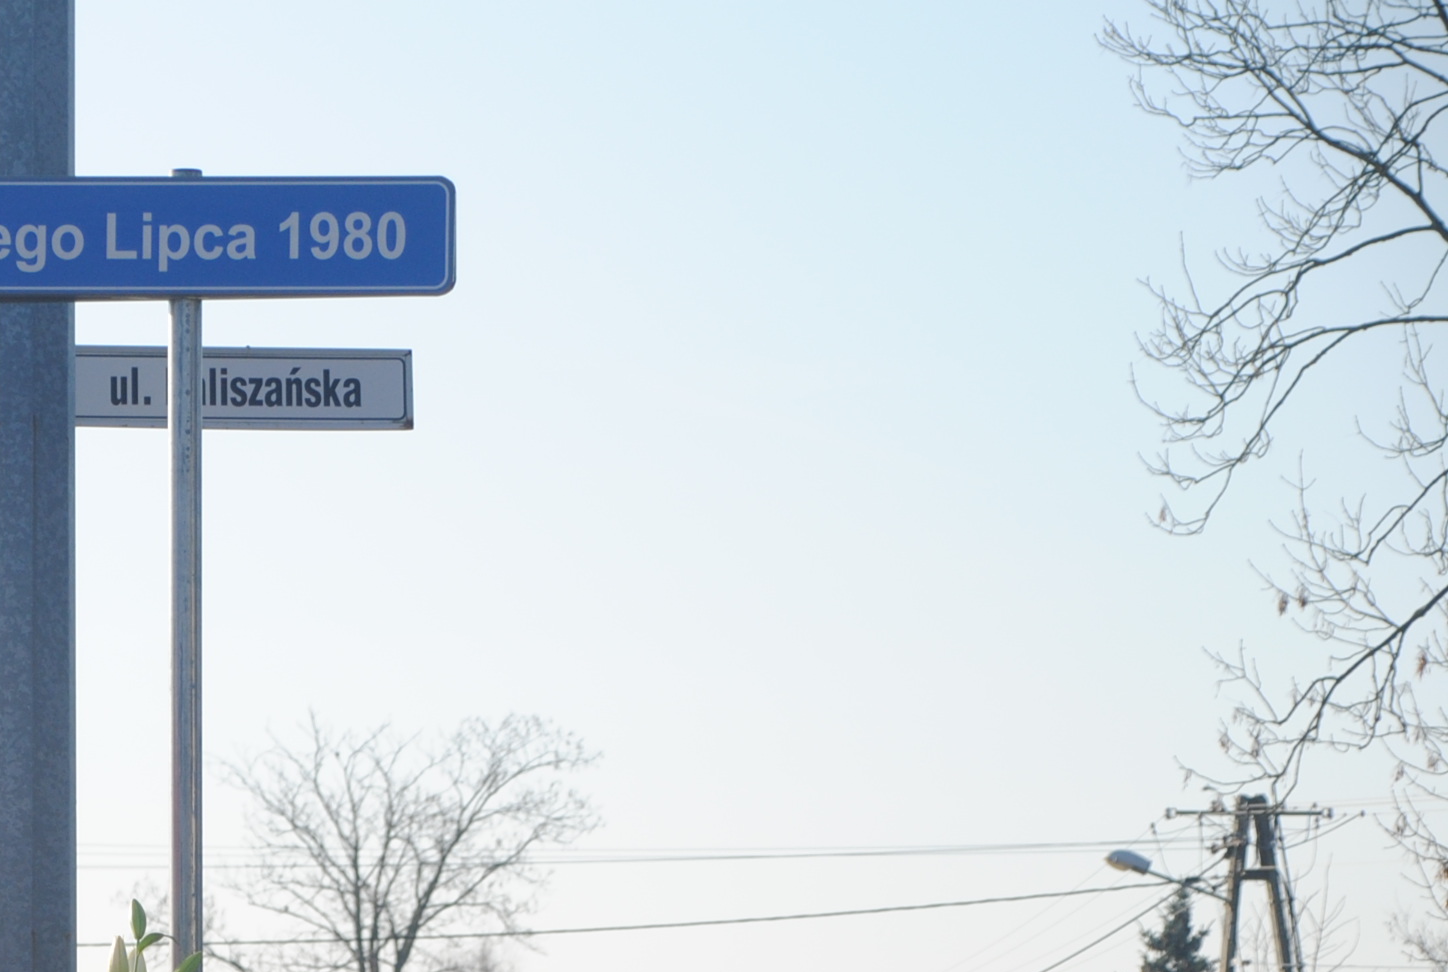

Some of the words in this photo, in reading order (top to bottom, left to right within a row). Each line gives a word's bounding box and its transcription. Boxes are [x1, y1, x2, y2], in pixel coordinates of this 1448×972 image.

[106, 212, 257, 272] Lipca
[278, 211, 407, 260] 1980
[110, 366, 152, 406] ul.
[165, 366, 362, 408] liszańska
